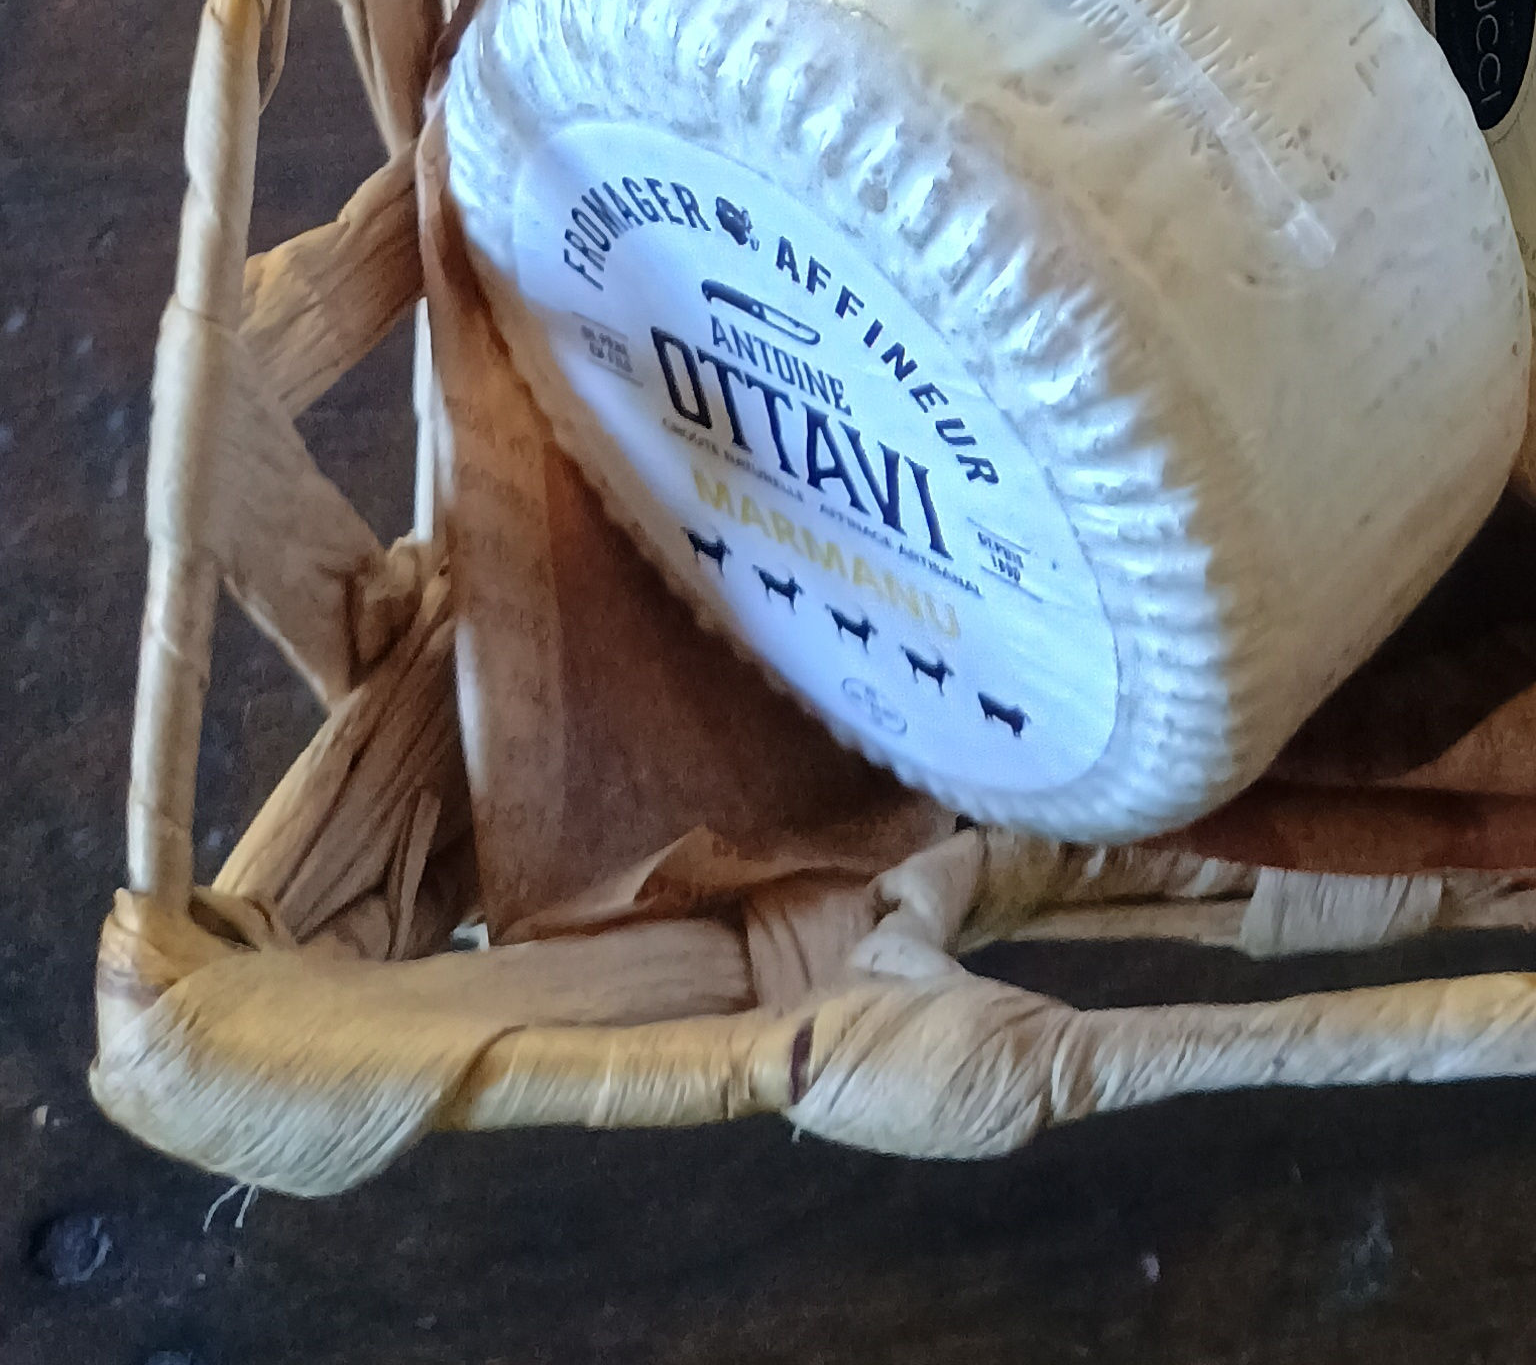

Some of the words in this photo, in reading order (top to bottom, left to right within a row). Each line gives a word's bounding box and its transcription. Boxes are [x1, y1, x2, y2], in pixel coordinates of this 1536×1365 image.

[563, 176, 711, 292] FROMAGER
[775, 236, 1000, 486] AFFINEUR
[711, 314, 852, 417] ANTOINE
[650, 325, 954, 560] OTTAVI
[692, 466, 961, 639] MARMANU
